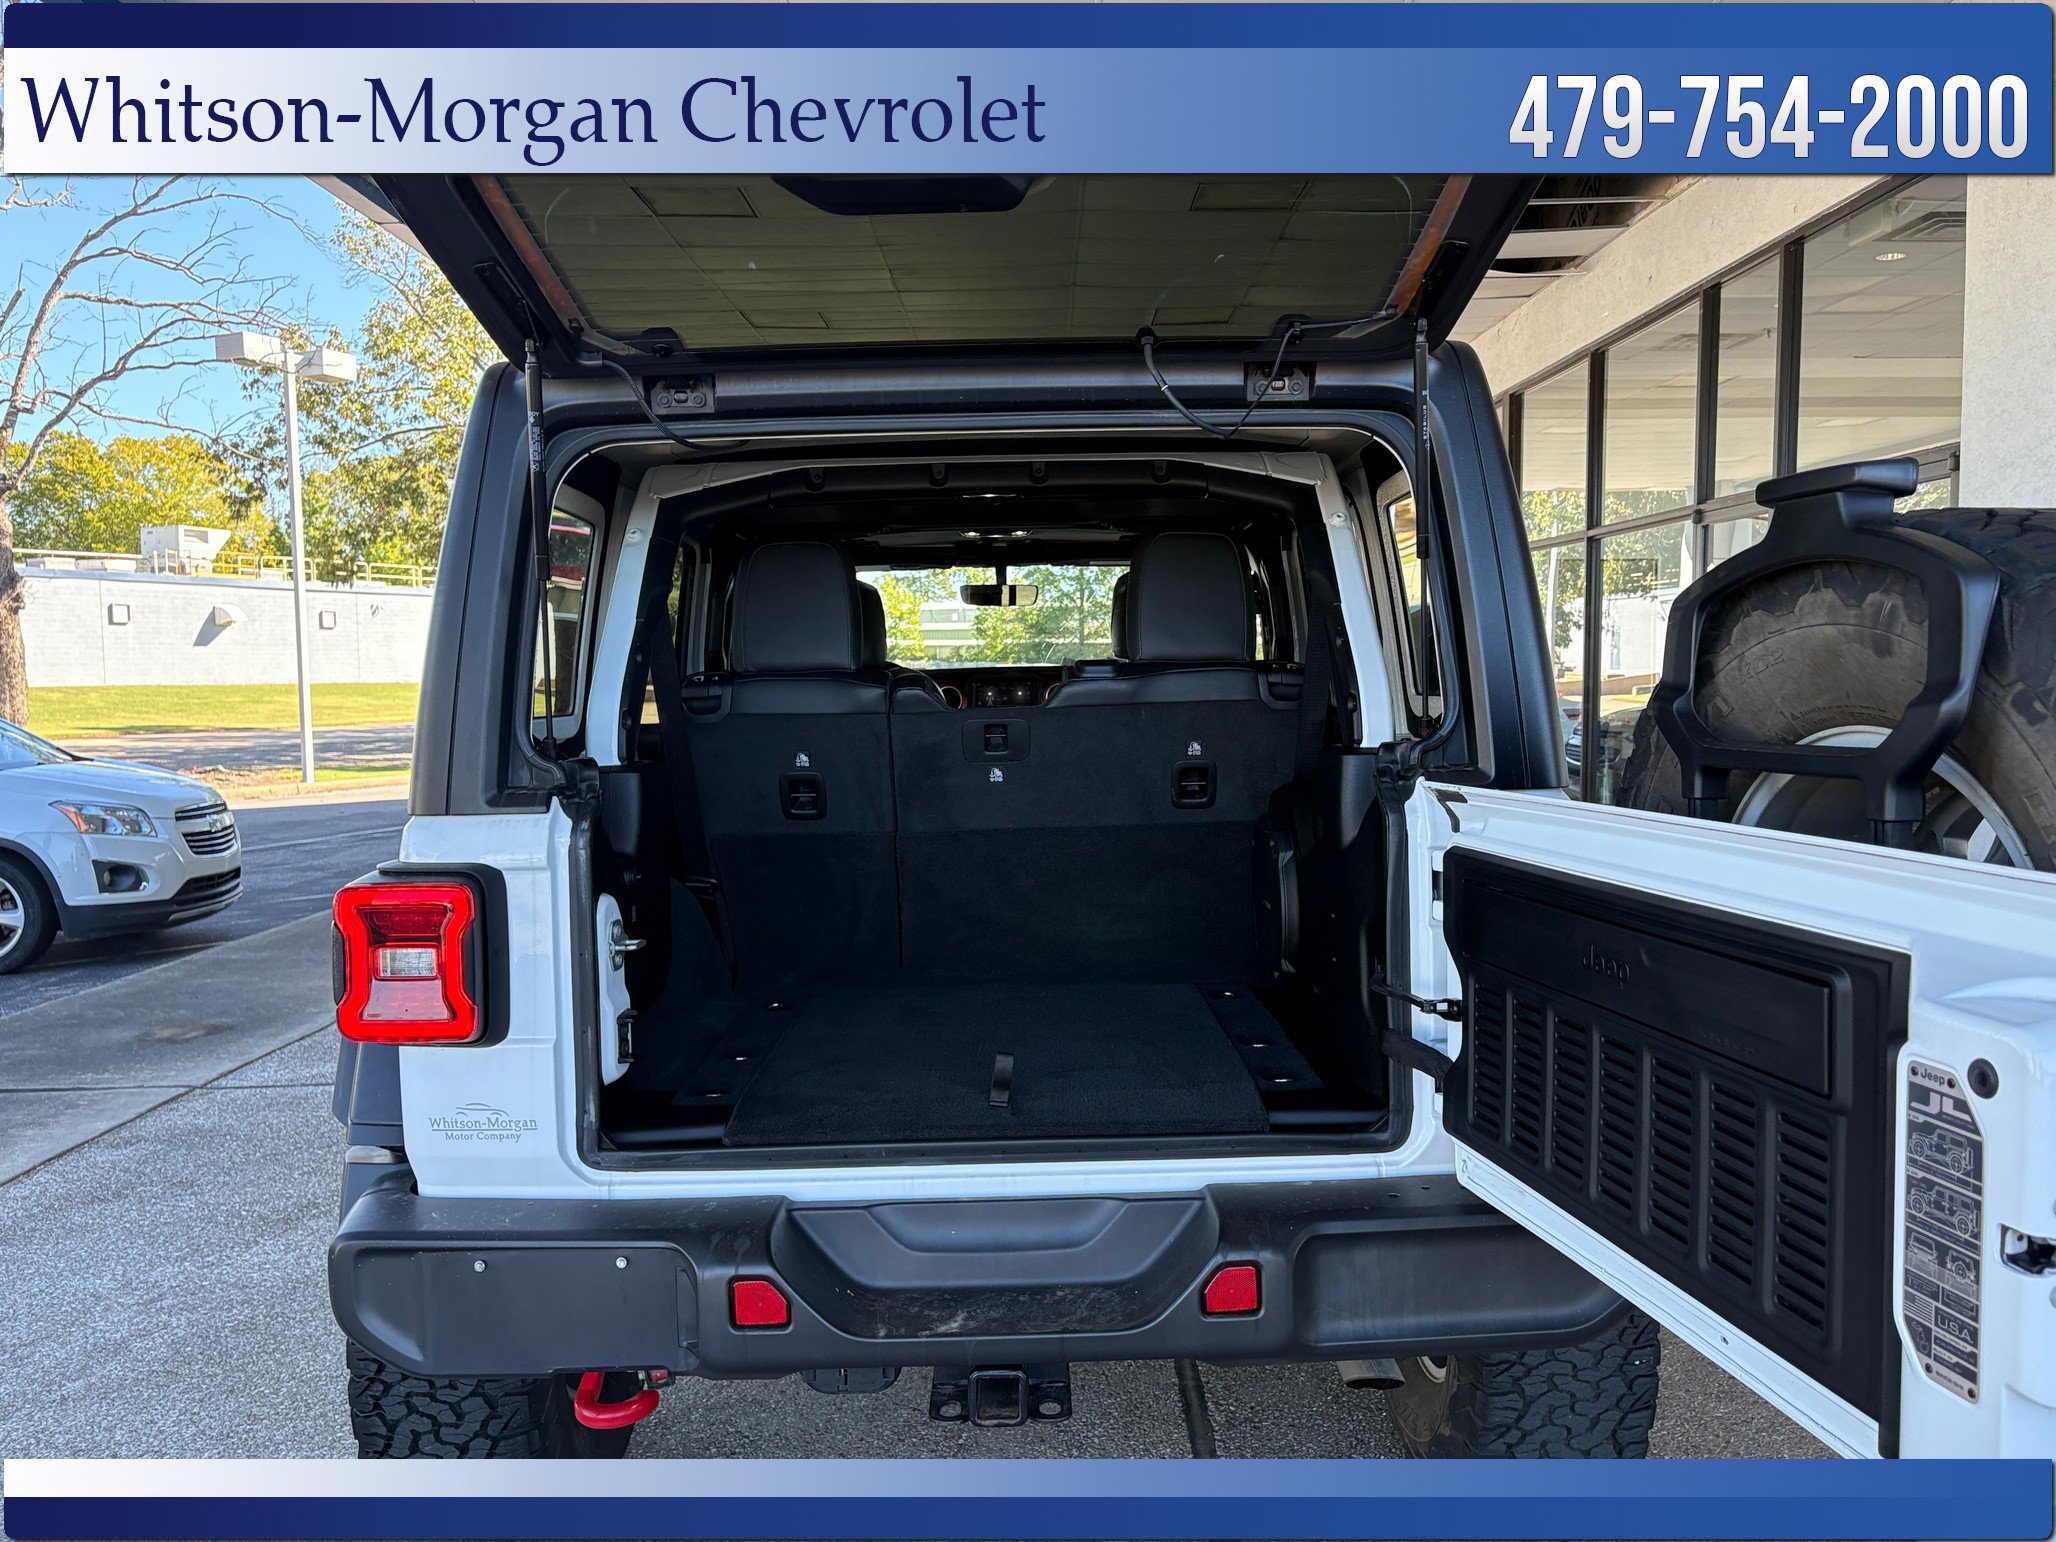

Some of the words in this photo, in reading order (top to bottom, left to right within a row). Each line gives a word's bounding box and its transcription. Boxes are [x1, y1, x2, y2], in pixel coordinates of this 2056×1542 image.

[1582, 944, 1630, 990] Jeep
[1921, 1068, 1946, 1086] Jeep
[1910, 1092, 1973, 1123] JL
[428, 1117, 538, 1131] Whitson-Morgan
[445, 1132, 474, 1141] Motor
[476, 1132, 522, 1143] Company
[1937, 1315, 1974, 1343] U.S.A.
